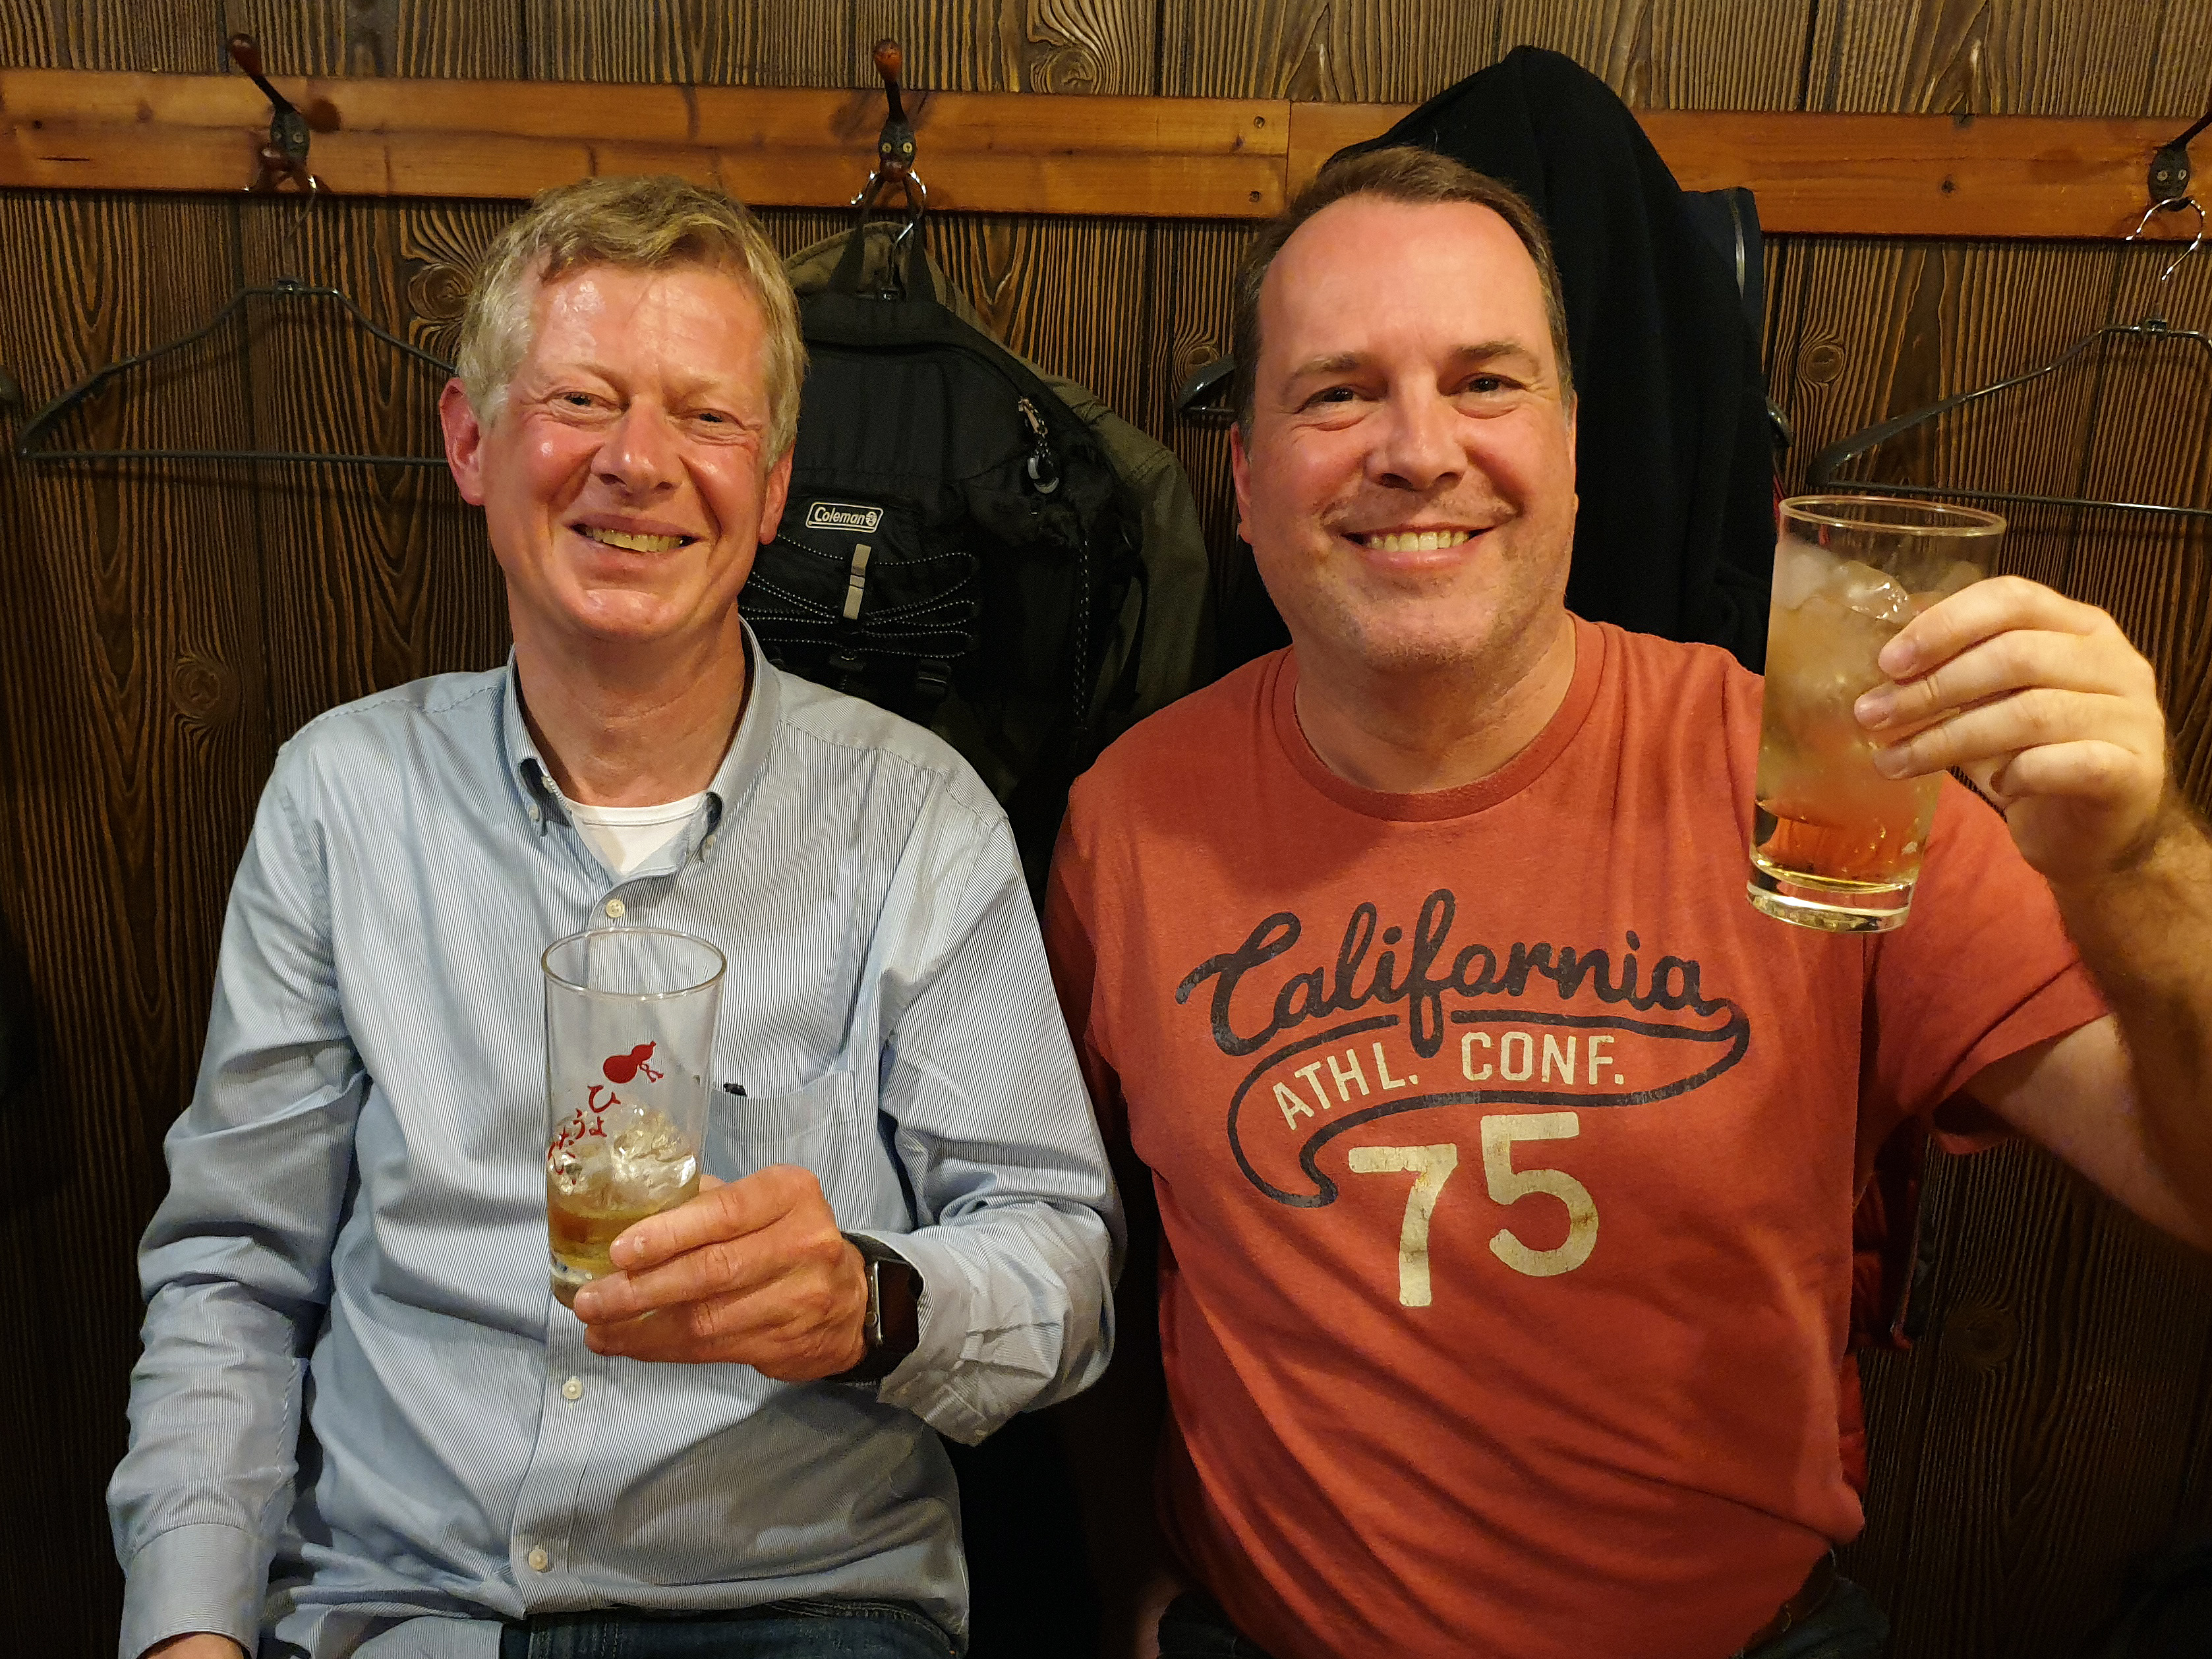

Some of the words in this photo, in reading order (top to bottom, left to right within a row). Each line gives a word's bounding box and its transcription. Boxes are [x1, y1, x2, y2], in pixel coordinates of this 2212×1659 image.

[814, 506, 865, 525] Coleman
[1175, 888, 1719, 1058] California
[1271, 1041, 1419, 1130] ATHL.
[1460, 1031, 1625, 1086] CONF.
[1347, 1111, 1600, 1307] 75
